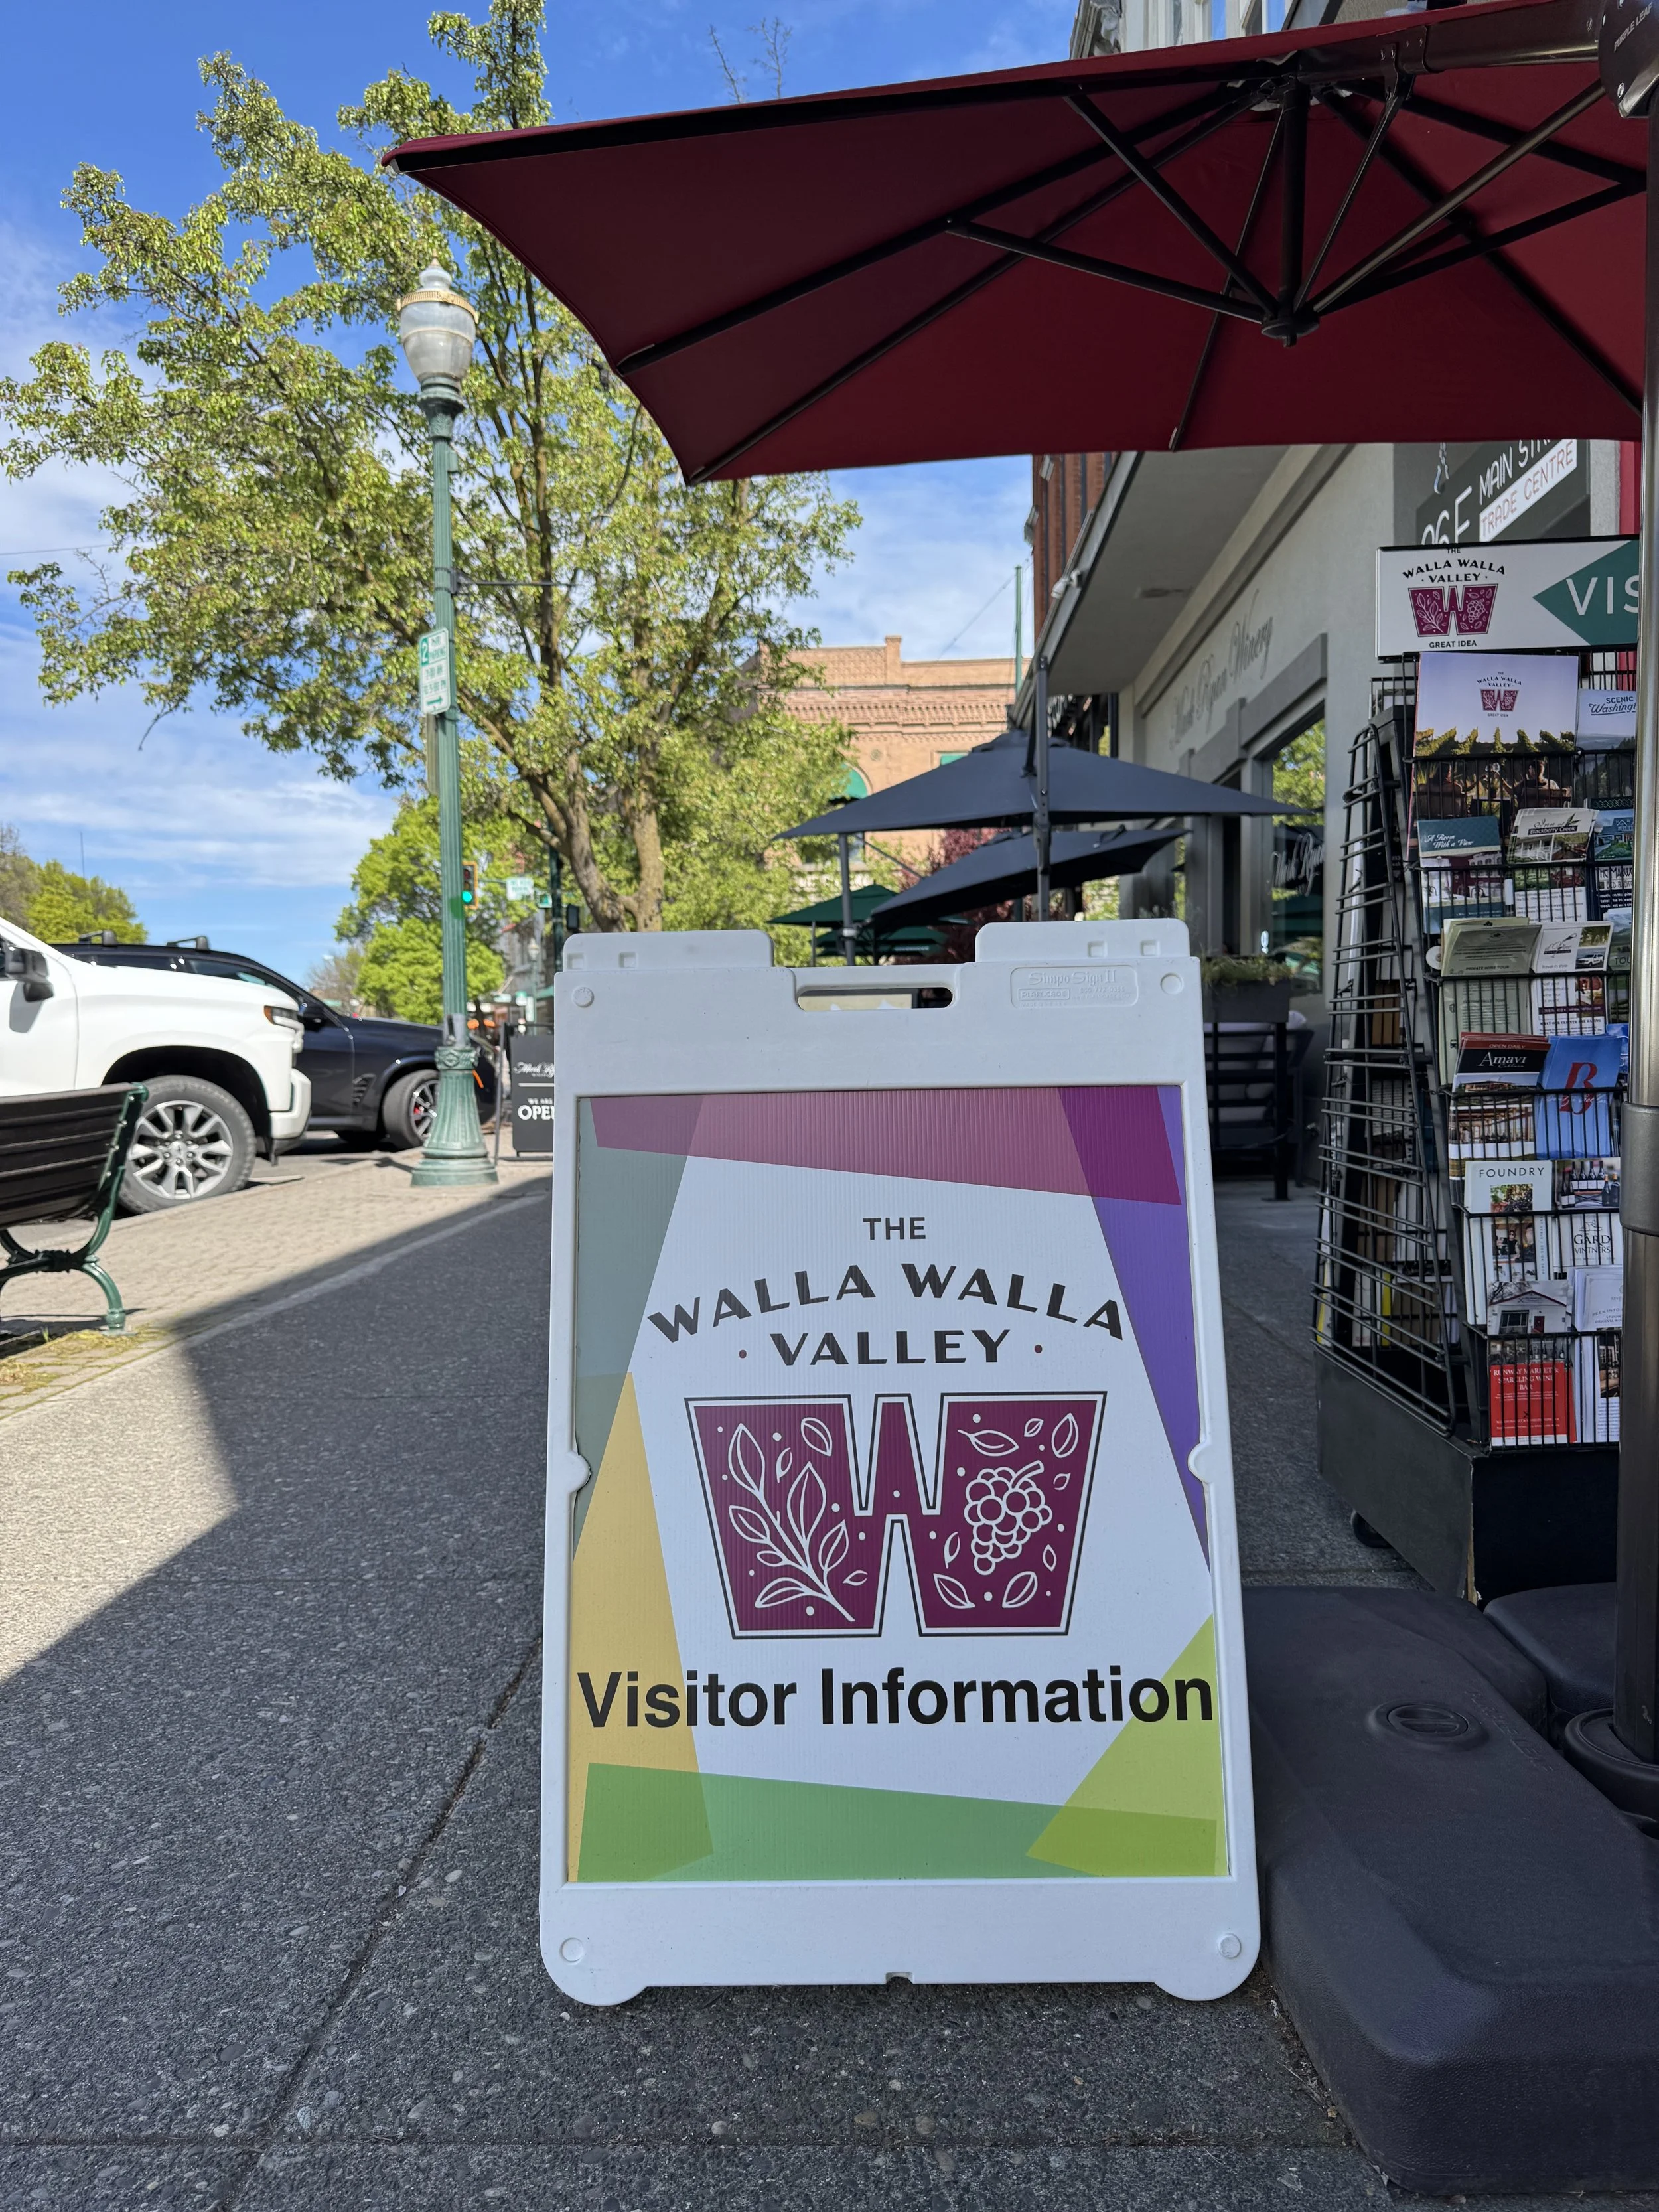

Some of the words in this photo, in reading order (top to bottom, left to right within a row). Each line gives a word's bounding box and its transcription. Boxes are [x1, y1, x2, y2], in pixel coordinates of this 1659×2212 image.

[1614, 20, 1634, 52] PURPLE
[1636, 2, 1652, 26] LEAF
[1479, 446, 1512, 505] MAIN
[1481, 490, 1517, 537] TRADE
[1524, 441, 1573, 500] CENTRE
[1402, 560, 1452, 579] WALLA
[1457, 559, 1505, 575] WALLA
[1429, 573, 1480, 583] VALLEY
[1500, 676, 1522, 685] WALLA
[1479, 1167, 1544, 1178] FOUNDRY
[863, 1217, 926, 1240] THE
[648, 1264, 876, 1343] WALLA
[901, 1263, 1124, 1341] WALLA
[770, 1329, 1010, 1366] VALLEY
[577, 1668, 797, 1727] Visitor
[822, 1664, 1213, 1724] Information
